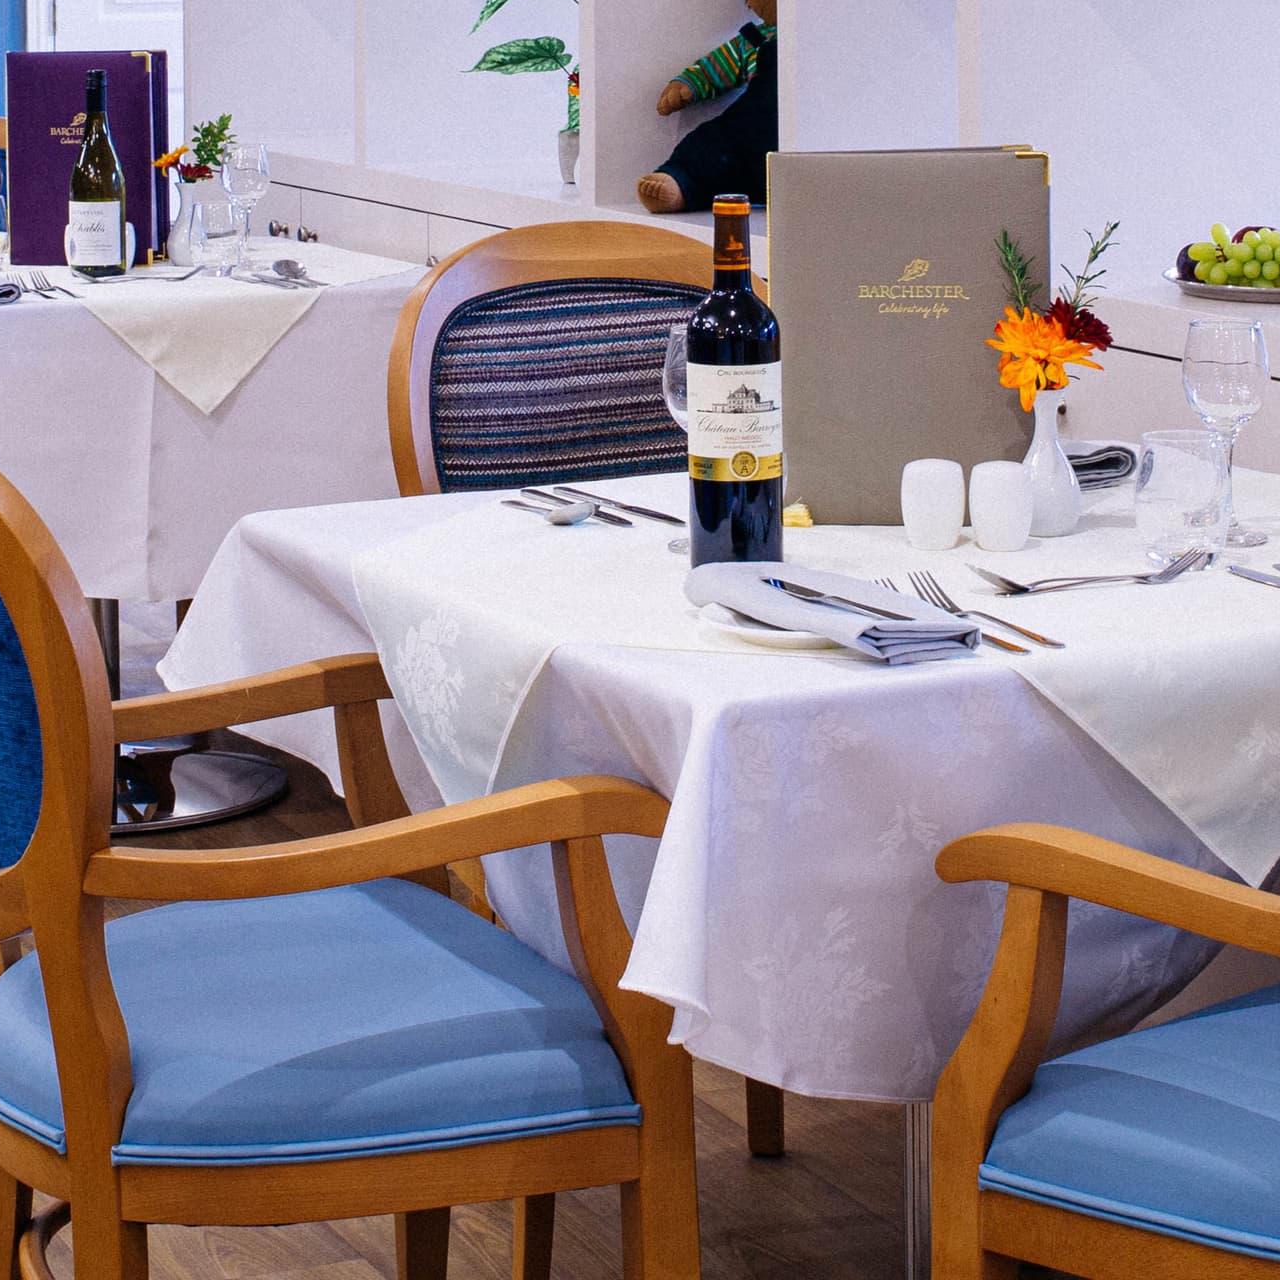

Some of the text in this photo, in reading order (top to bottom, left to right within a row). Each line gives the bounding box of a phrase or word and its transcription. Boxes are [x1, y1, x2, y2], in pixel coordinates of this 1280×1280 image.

[50, 127, 85, 136] BARCHE
[858, 284, 971, 300] BARCHESTER
[878, 302, 951, 319] Celebrating life
